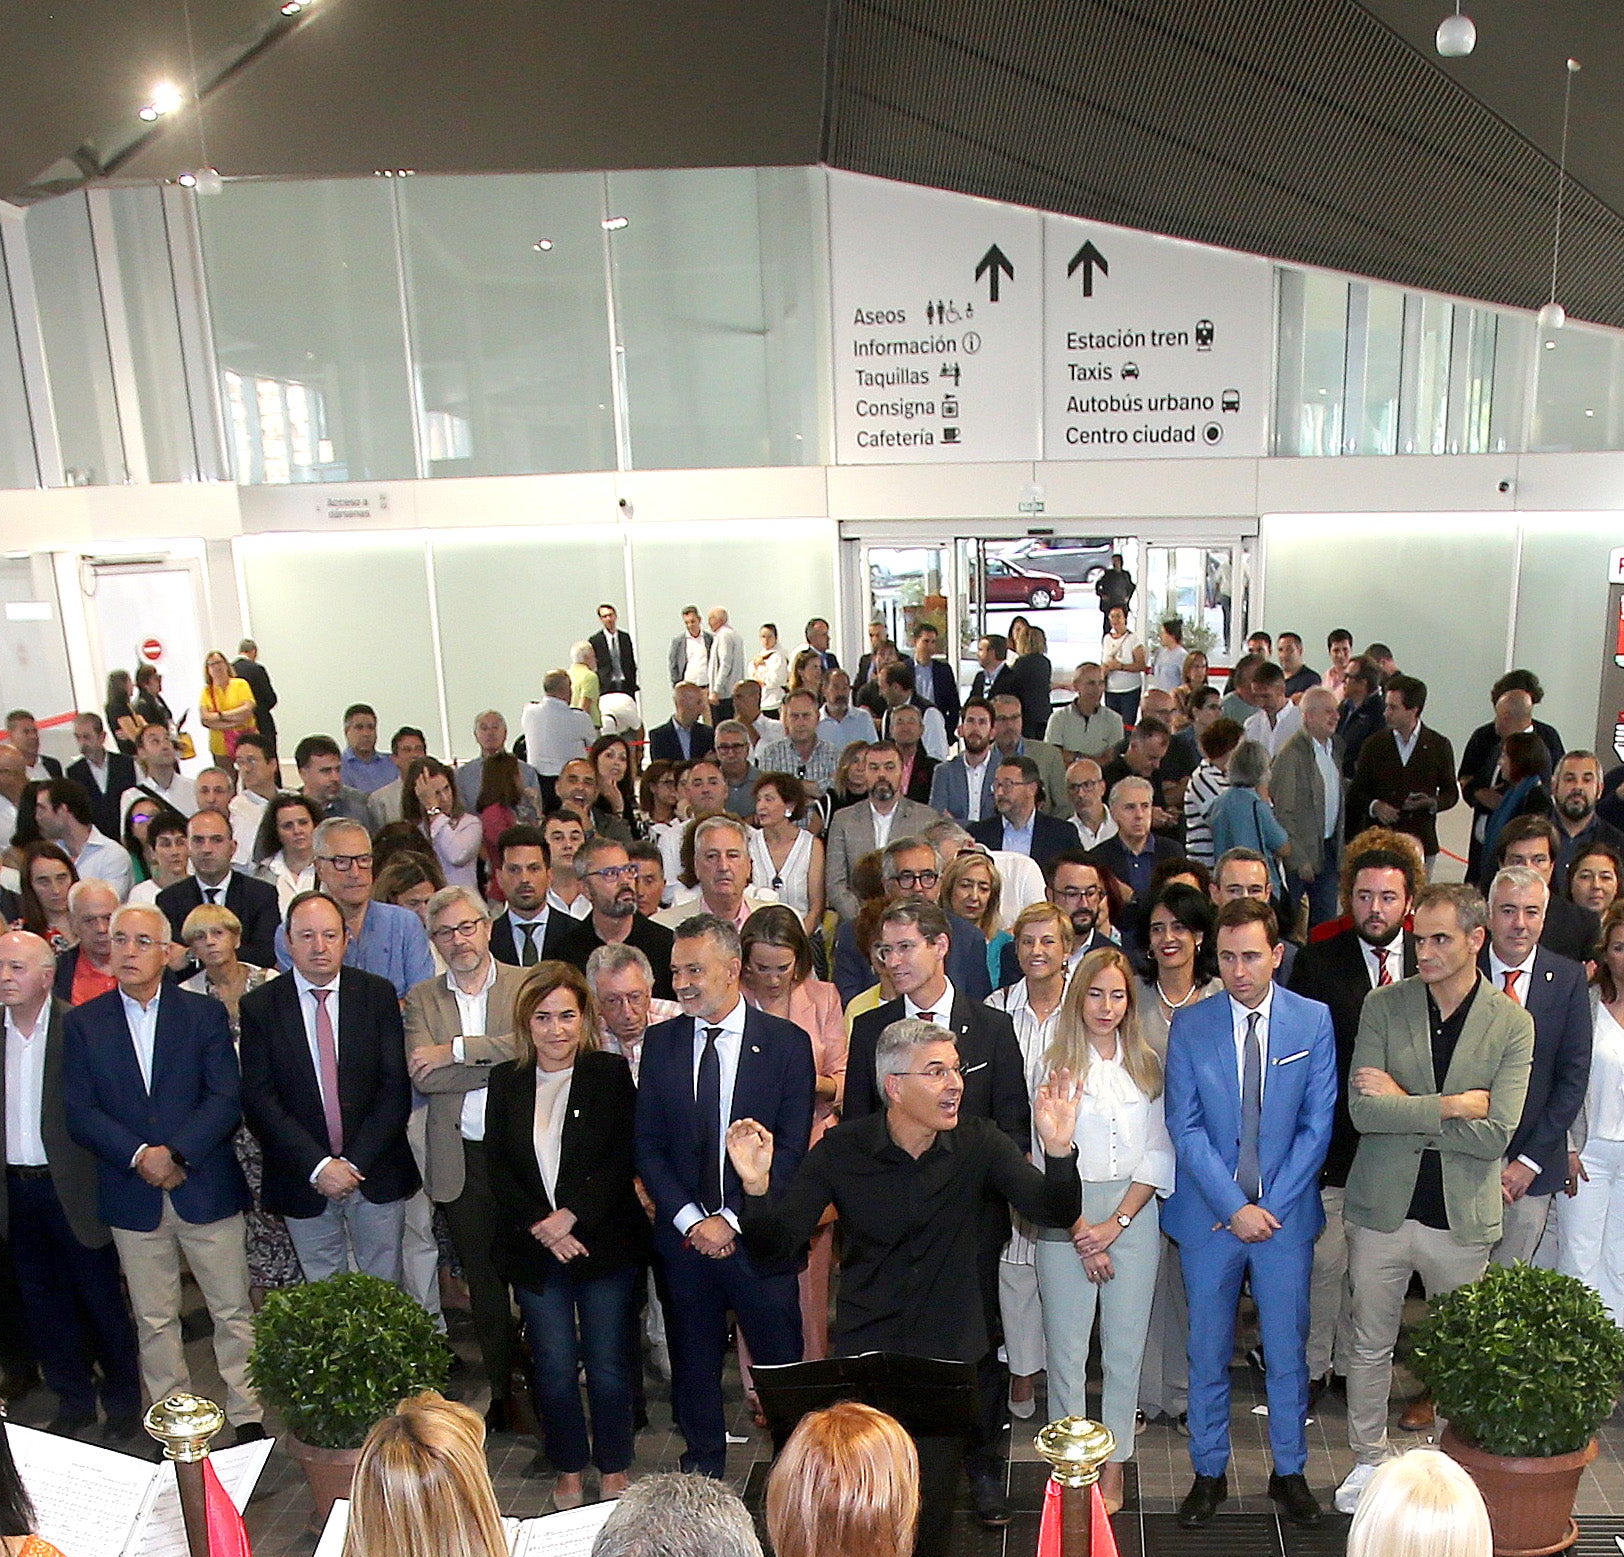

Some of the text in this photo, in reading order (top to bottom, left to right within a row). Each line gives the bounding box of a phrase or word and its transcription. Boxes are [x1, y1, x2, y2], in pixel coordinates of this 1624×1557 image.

[854, 308, 906, 325] Aseos
[854, 335, 957, 356] Información
[1067, 329, 1189, 349] Estación tren
[855, 367, 929, 388] Taquillas
[1068, 362, 1112, 380] Taxis
[856, 398, 935, 419] Consigna
[1067, 394, 1214, 413] Autobús urbano
[856, 428, 934, 447] Cafetería
[1066, 425, 1195, 444] Centro ciudad
